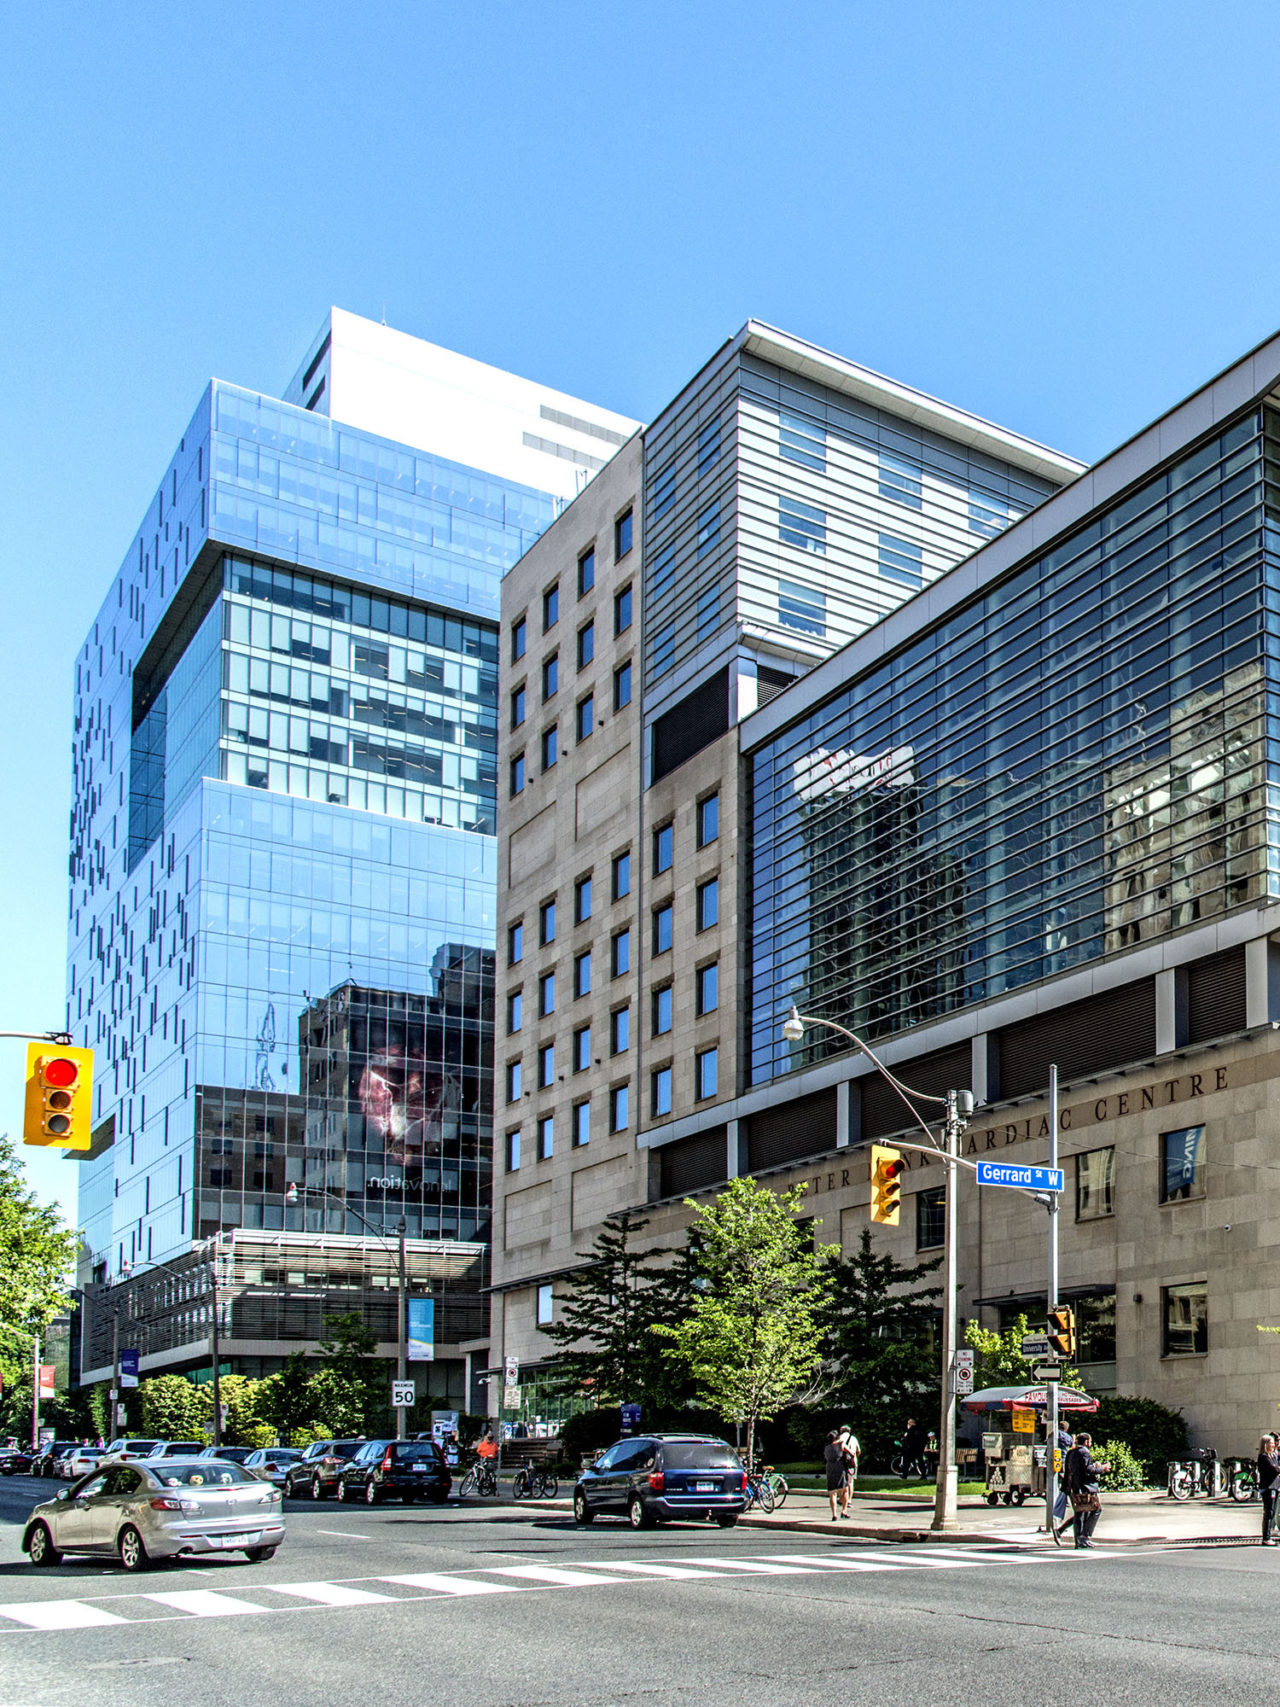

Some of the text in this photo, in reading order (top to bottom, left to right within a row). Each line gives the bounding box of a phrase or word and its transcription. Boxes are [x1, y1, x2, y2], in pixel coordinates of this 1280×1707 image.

[966, 1109, 1072, 1155] ARDIAC
[1094, 1066, 1228, 1121] CENTRE
[982, 1164, 1059, 1186] Gerrard St W
[395, 1391, 414, 1403] 50
